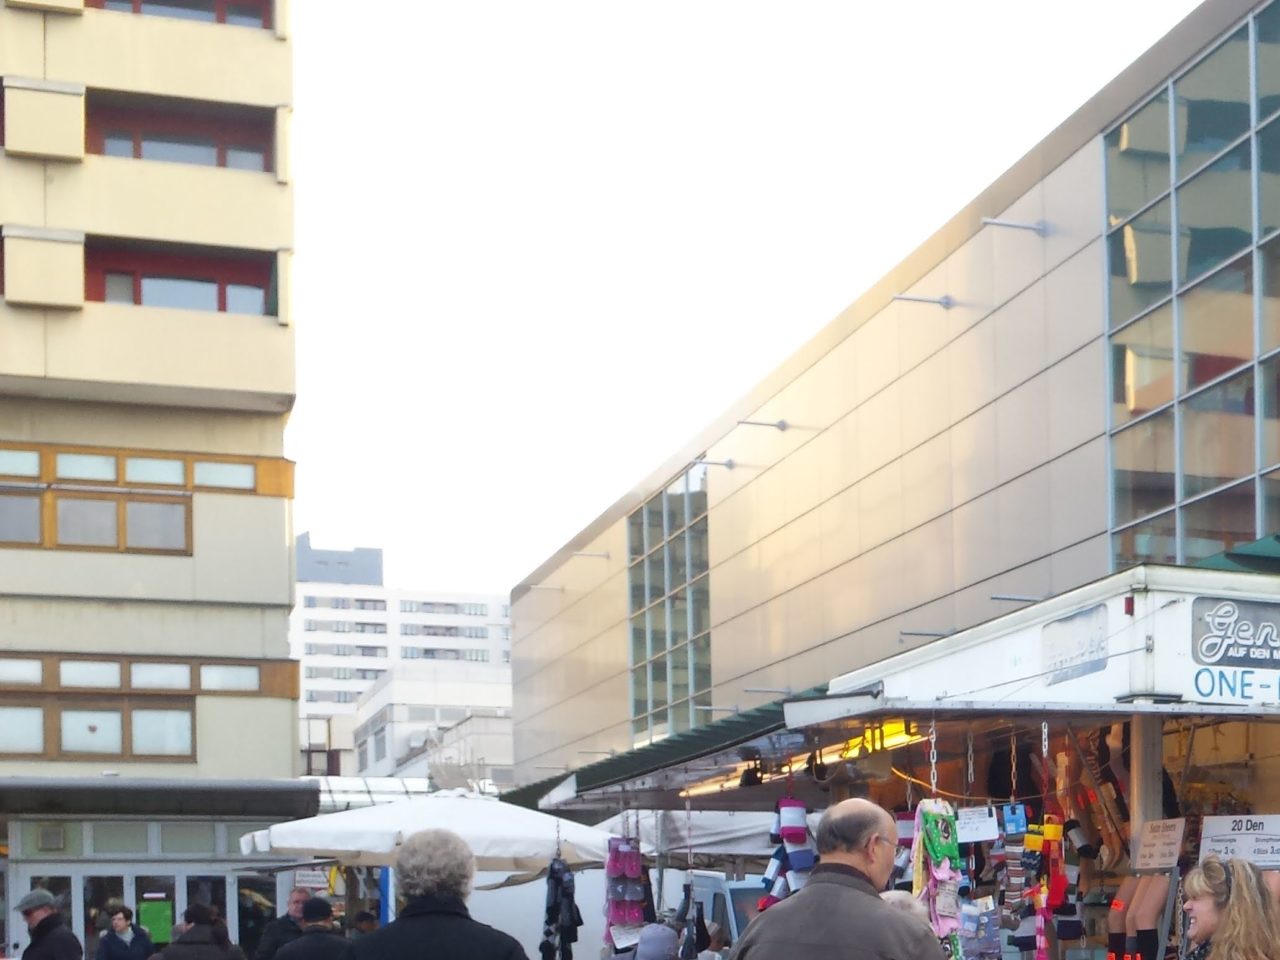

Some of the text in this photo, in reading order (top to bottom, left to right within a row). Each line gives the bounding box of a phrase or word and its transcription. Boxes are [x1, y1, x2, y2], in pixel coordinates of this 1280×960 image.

[1227, 646, 1247, 658] AUF
[1250, 648, 1271, 660] DEN
[1231, 819, 1265, 832] 20 Den
